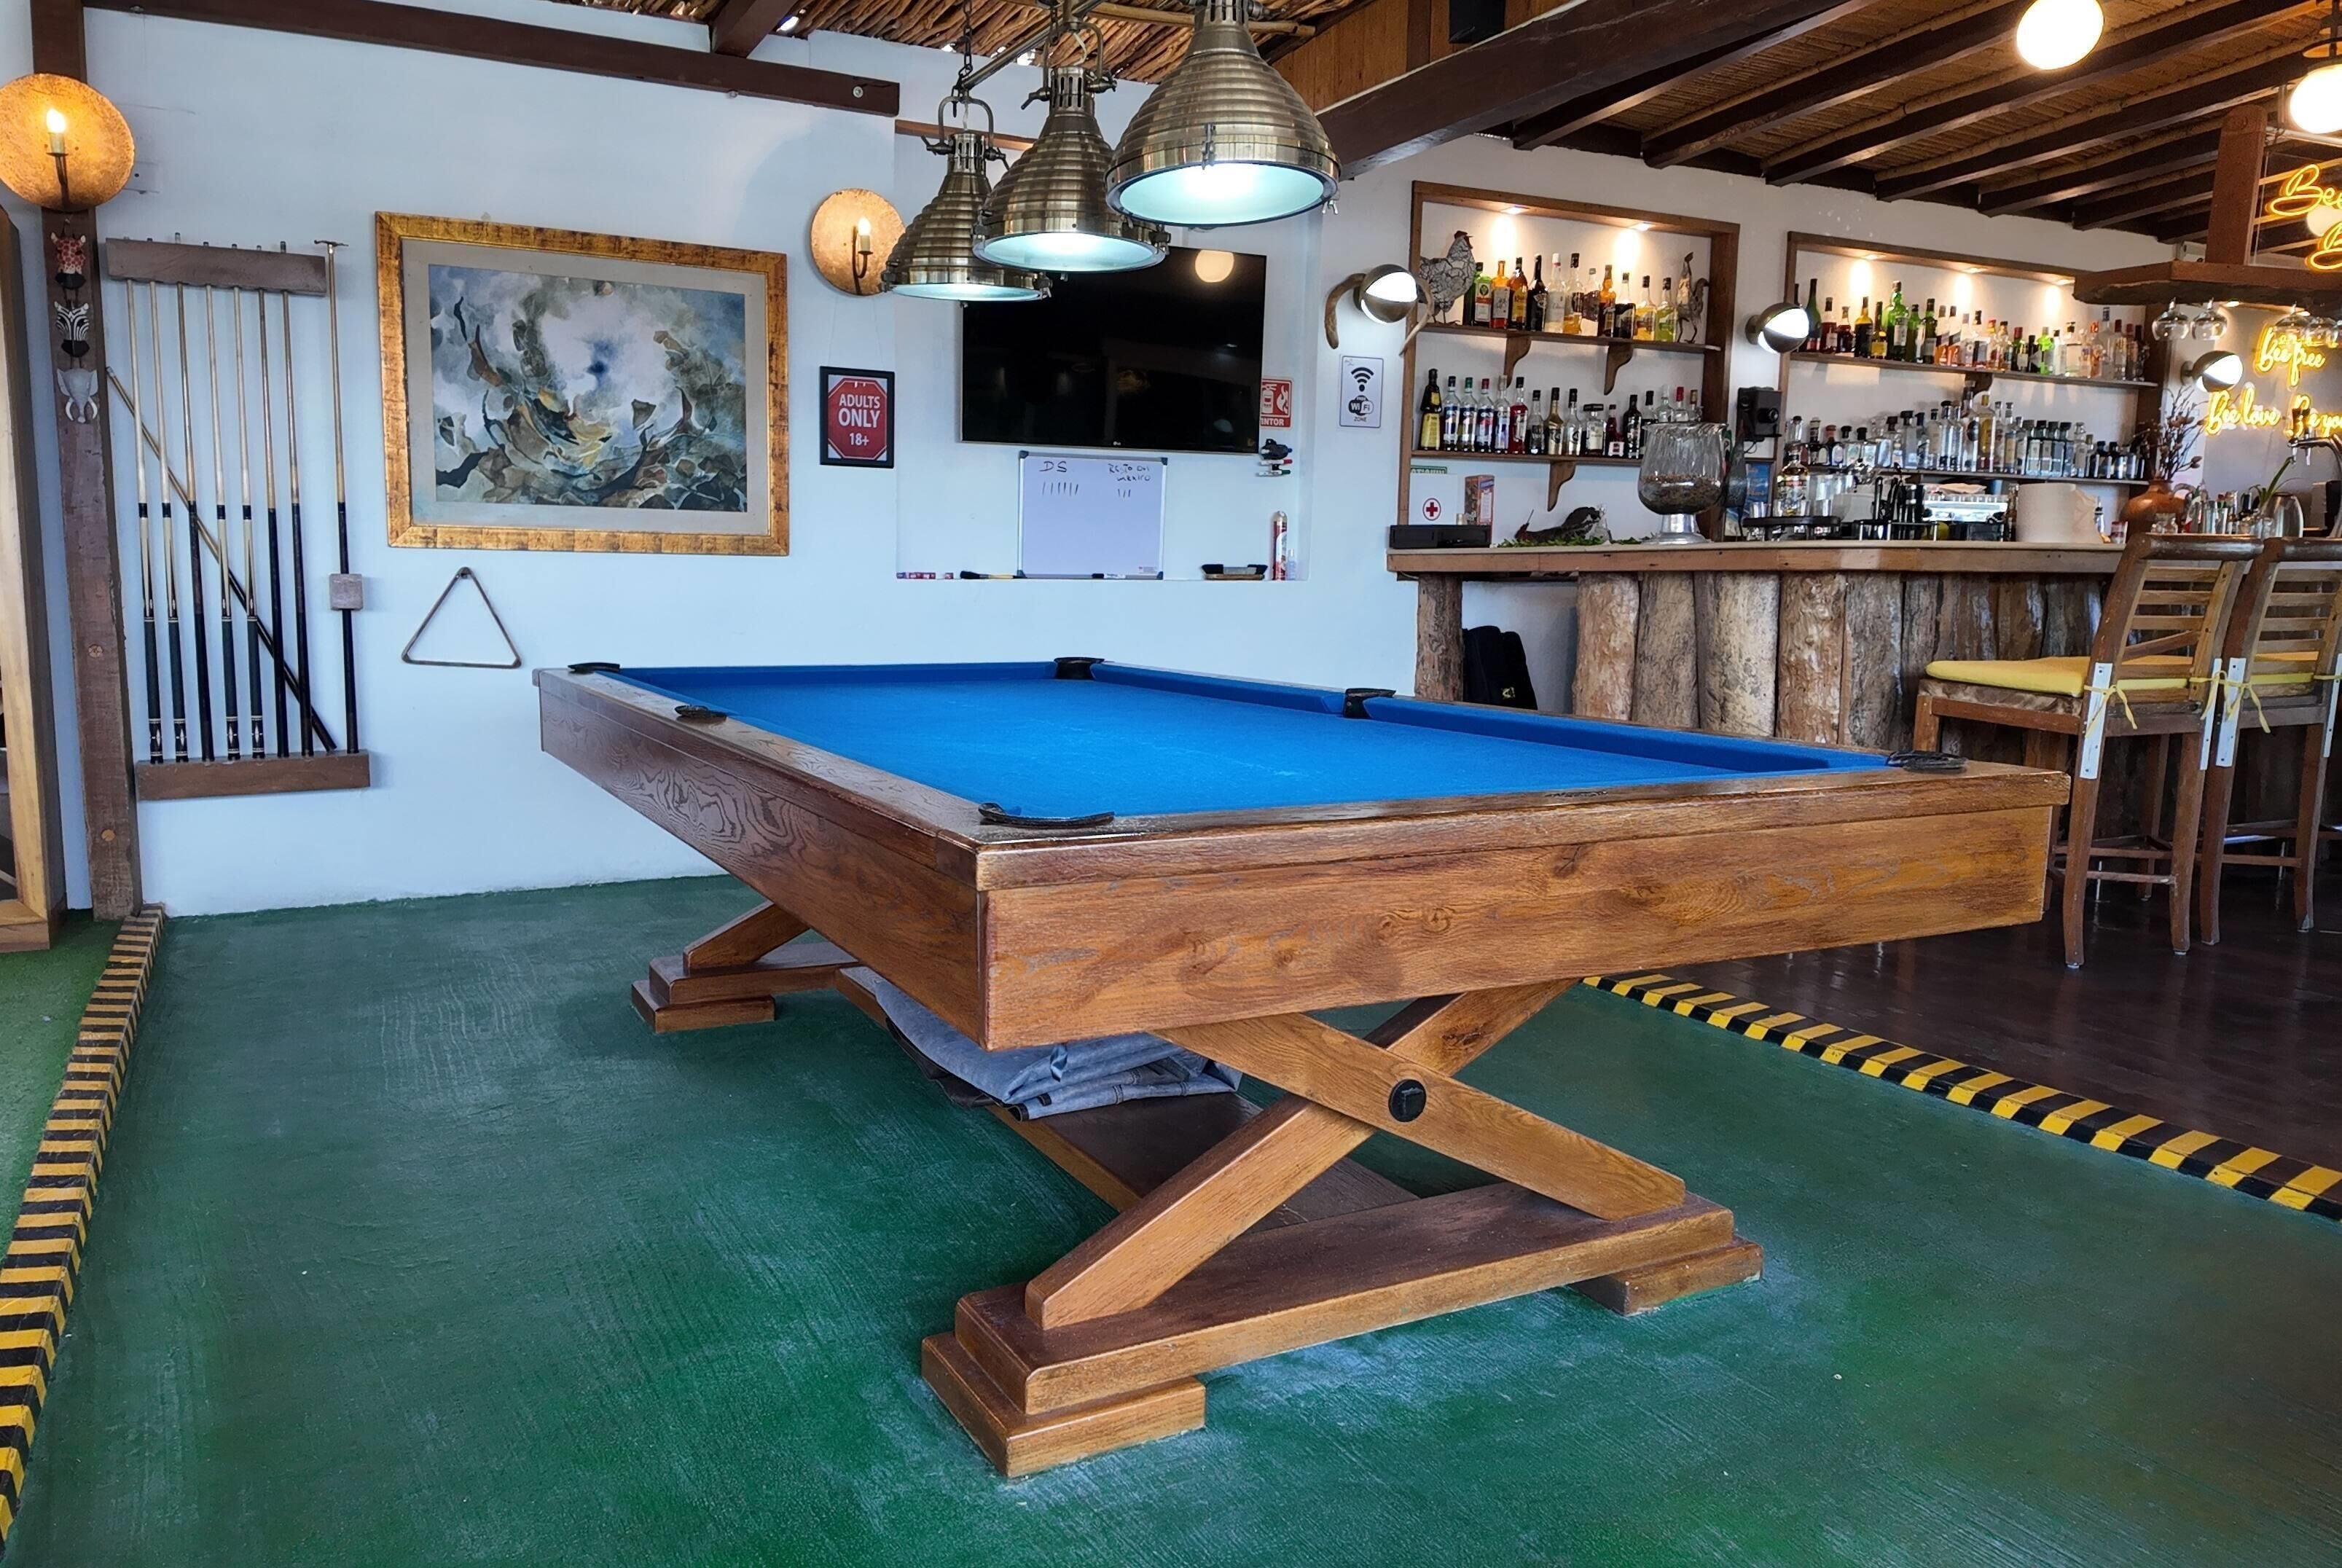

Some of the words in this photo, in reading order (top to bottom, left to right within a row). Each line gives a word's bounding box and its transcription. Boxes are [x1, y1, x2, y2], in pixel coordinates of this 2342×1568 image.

[839, 393, 880, 409] ADULTS
[2243, 386, 2282, 426] love
[838, 407, 880, 428] ONLY
[1260, 417, 1285, 426] INTOR
[849, 432, 869, 446] 18+
